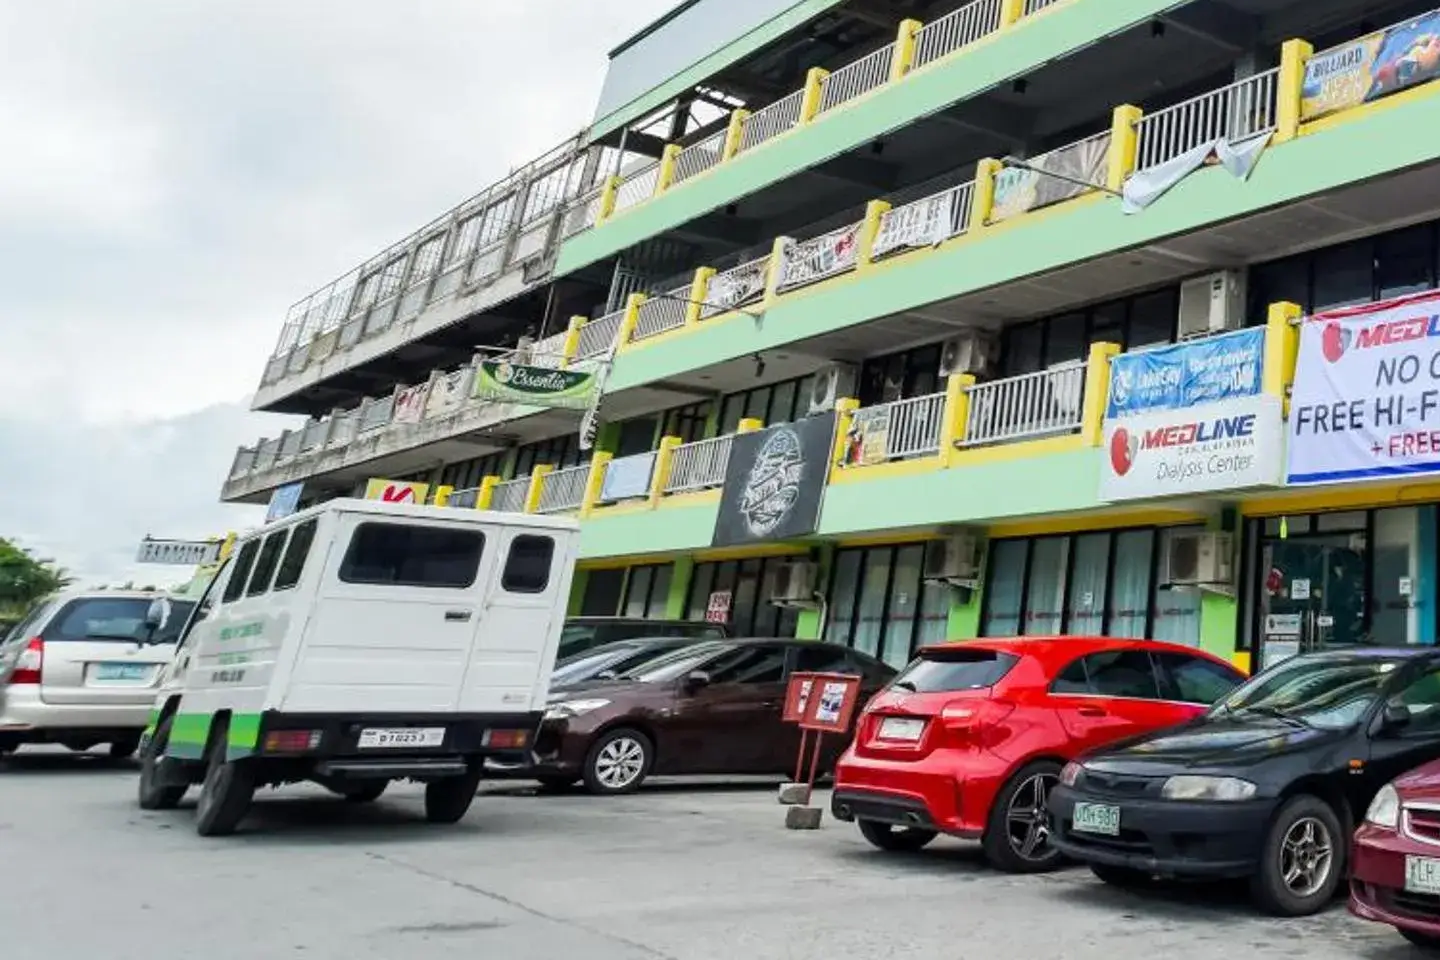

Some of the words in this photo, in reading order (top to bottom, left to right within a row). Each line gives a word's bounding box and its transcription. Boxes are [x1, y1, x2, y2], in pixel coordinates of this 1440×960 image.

[1312, 47, 1363, 79] BILLIARD
[1376, 356, 1421, 387] NO
[1141, 414, 1257, 451] MEDLINE
[1296, 398, 1366, 436] FREE
[1156, 461, 1203, 483] Dialysis
[1206, 453, 1254, 474] Center
